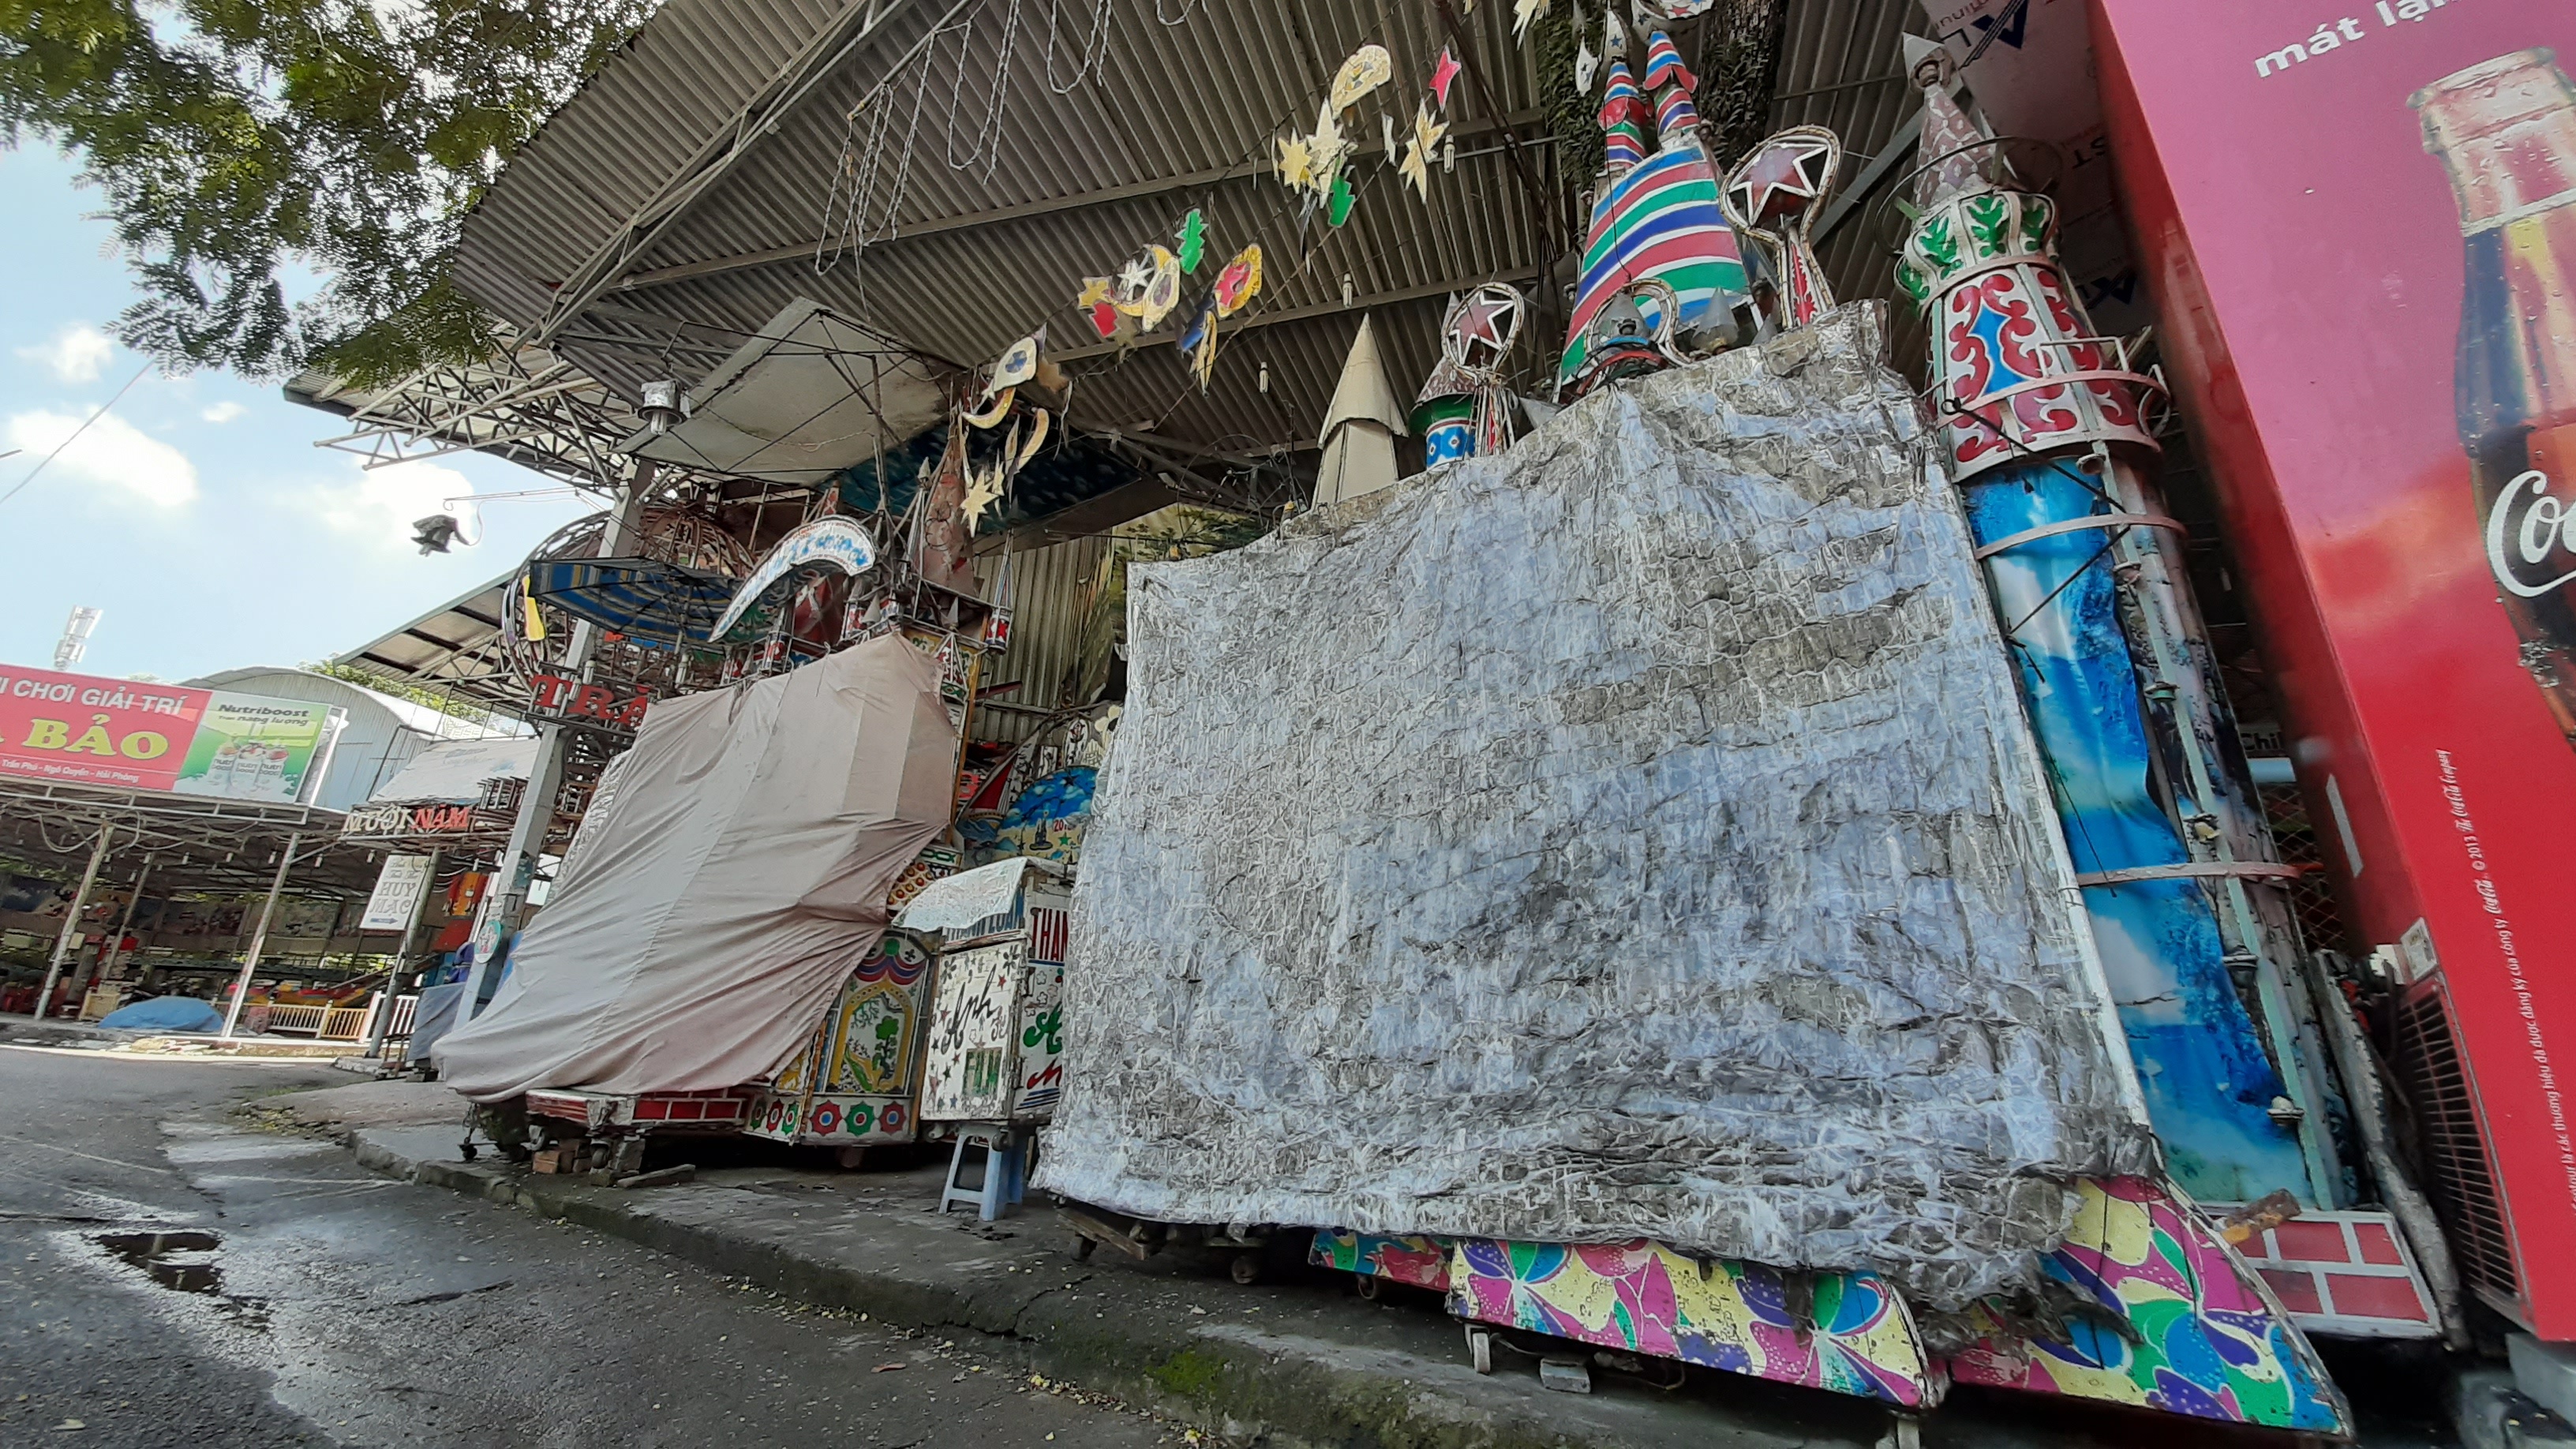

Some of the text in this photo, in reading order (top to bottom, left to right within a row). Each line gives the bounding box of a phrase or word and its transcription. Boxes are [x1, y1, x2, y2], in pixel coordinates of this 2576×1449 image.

[2254, 17, 2365, 78] mát
[13, 680, 77, 703] CHƠI
[80, 686, 135, 710] GIẢI
[141, 695, 189, 716] TRÍ
[219, 704, 309, 717] Nutriboost
[21, 713, 170, 760] BẢO
[2464, 835, 2484, 859] 2013
